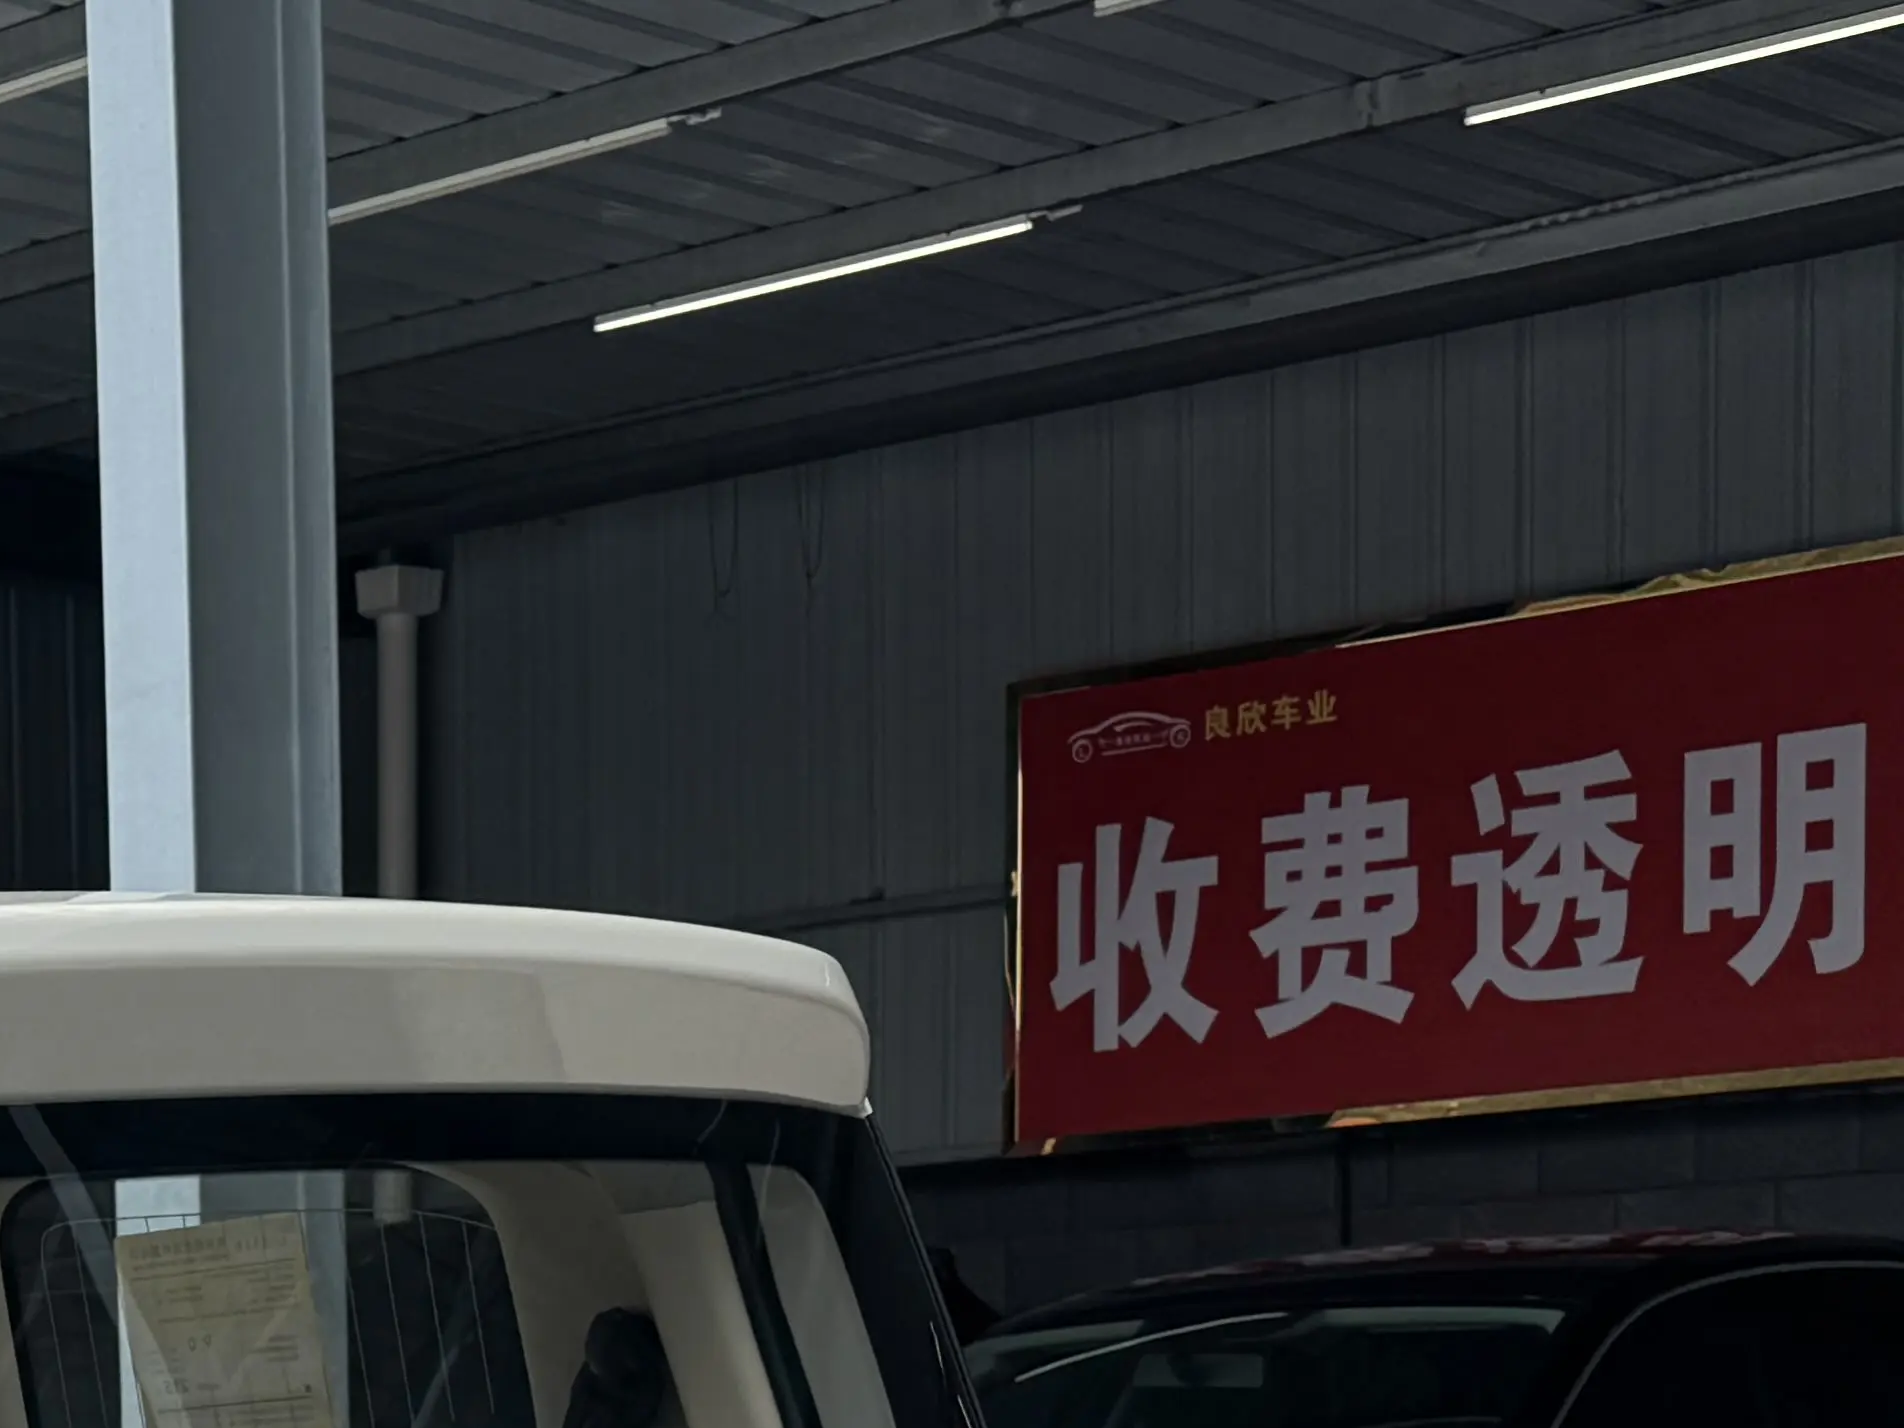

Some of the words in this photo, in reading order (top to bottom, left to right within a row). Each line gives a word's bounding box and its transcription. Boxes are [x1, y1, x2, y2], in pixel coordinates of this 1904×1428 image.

[1204, 690, 1338, 741] 良欣车业
[1049, 722, 1867, 1053] 收费透明
